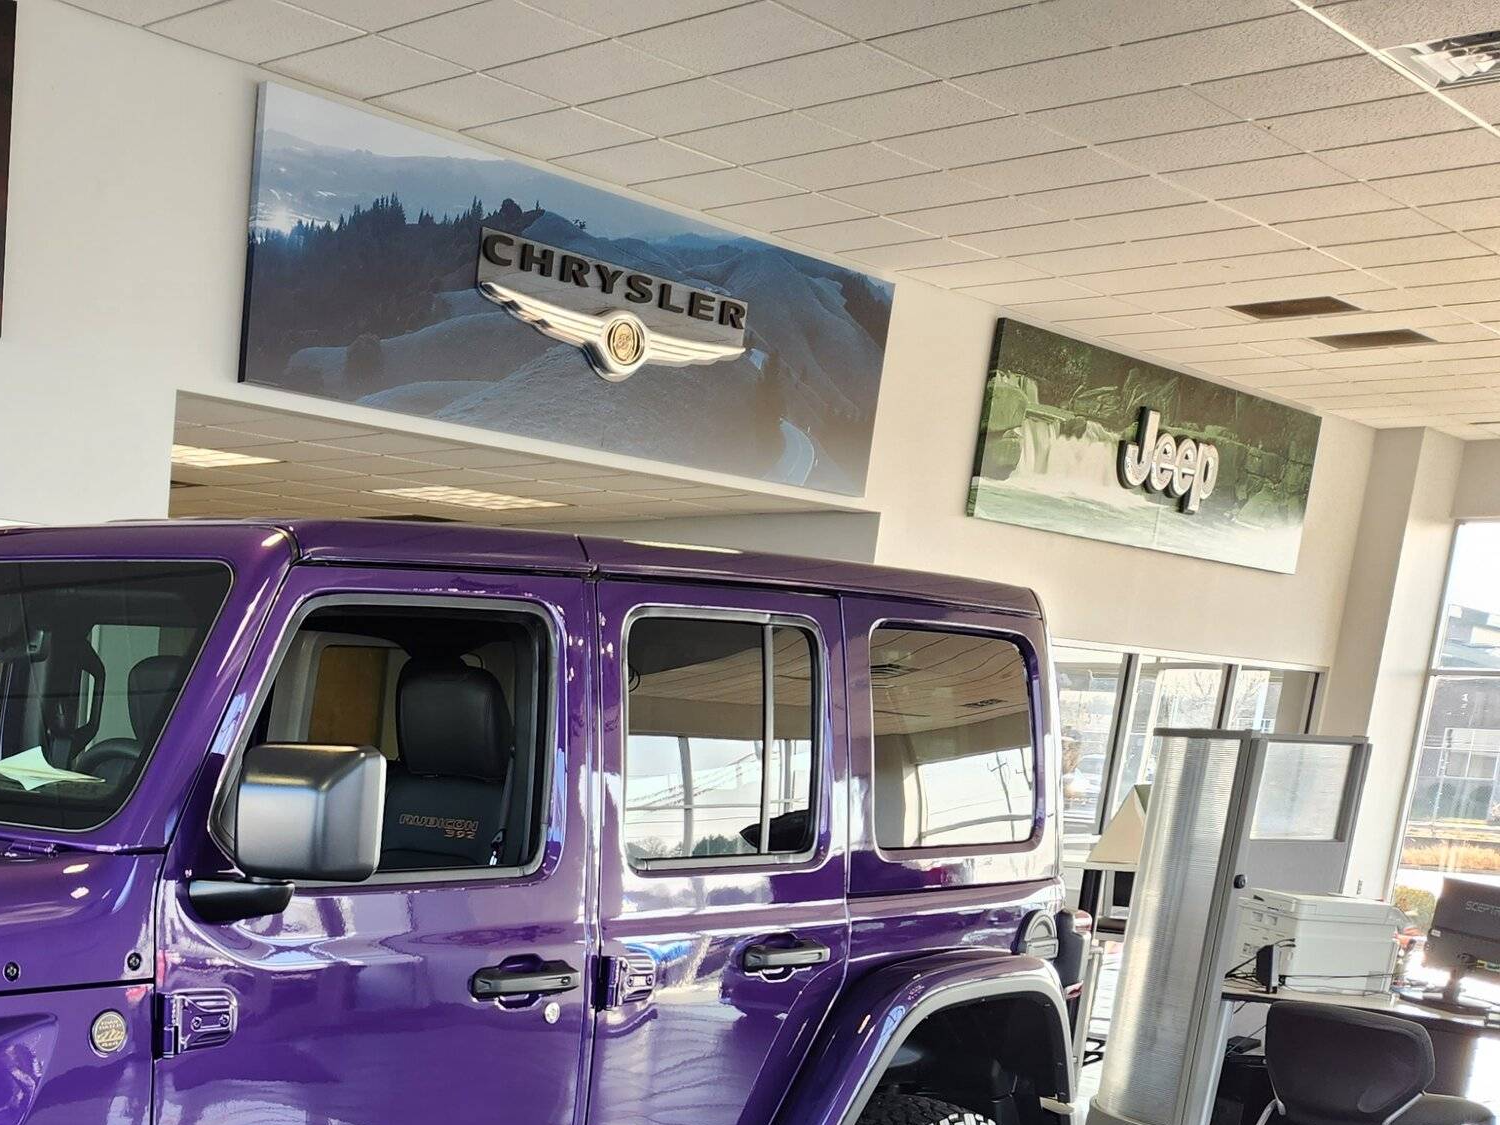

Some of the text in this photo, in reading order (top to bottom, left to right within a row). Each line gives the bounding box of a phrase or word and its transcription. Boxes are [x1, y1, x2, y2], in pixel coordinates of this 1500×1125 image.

[481, 233, 747, 330] CHRYSLER
[1116, 405, 1220, 515] Jeep
[398, 813, 479, 832] RUBICON
[443, 829, 477, 840] 392
